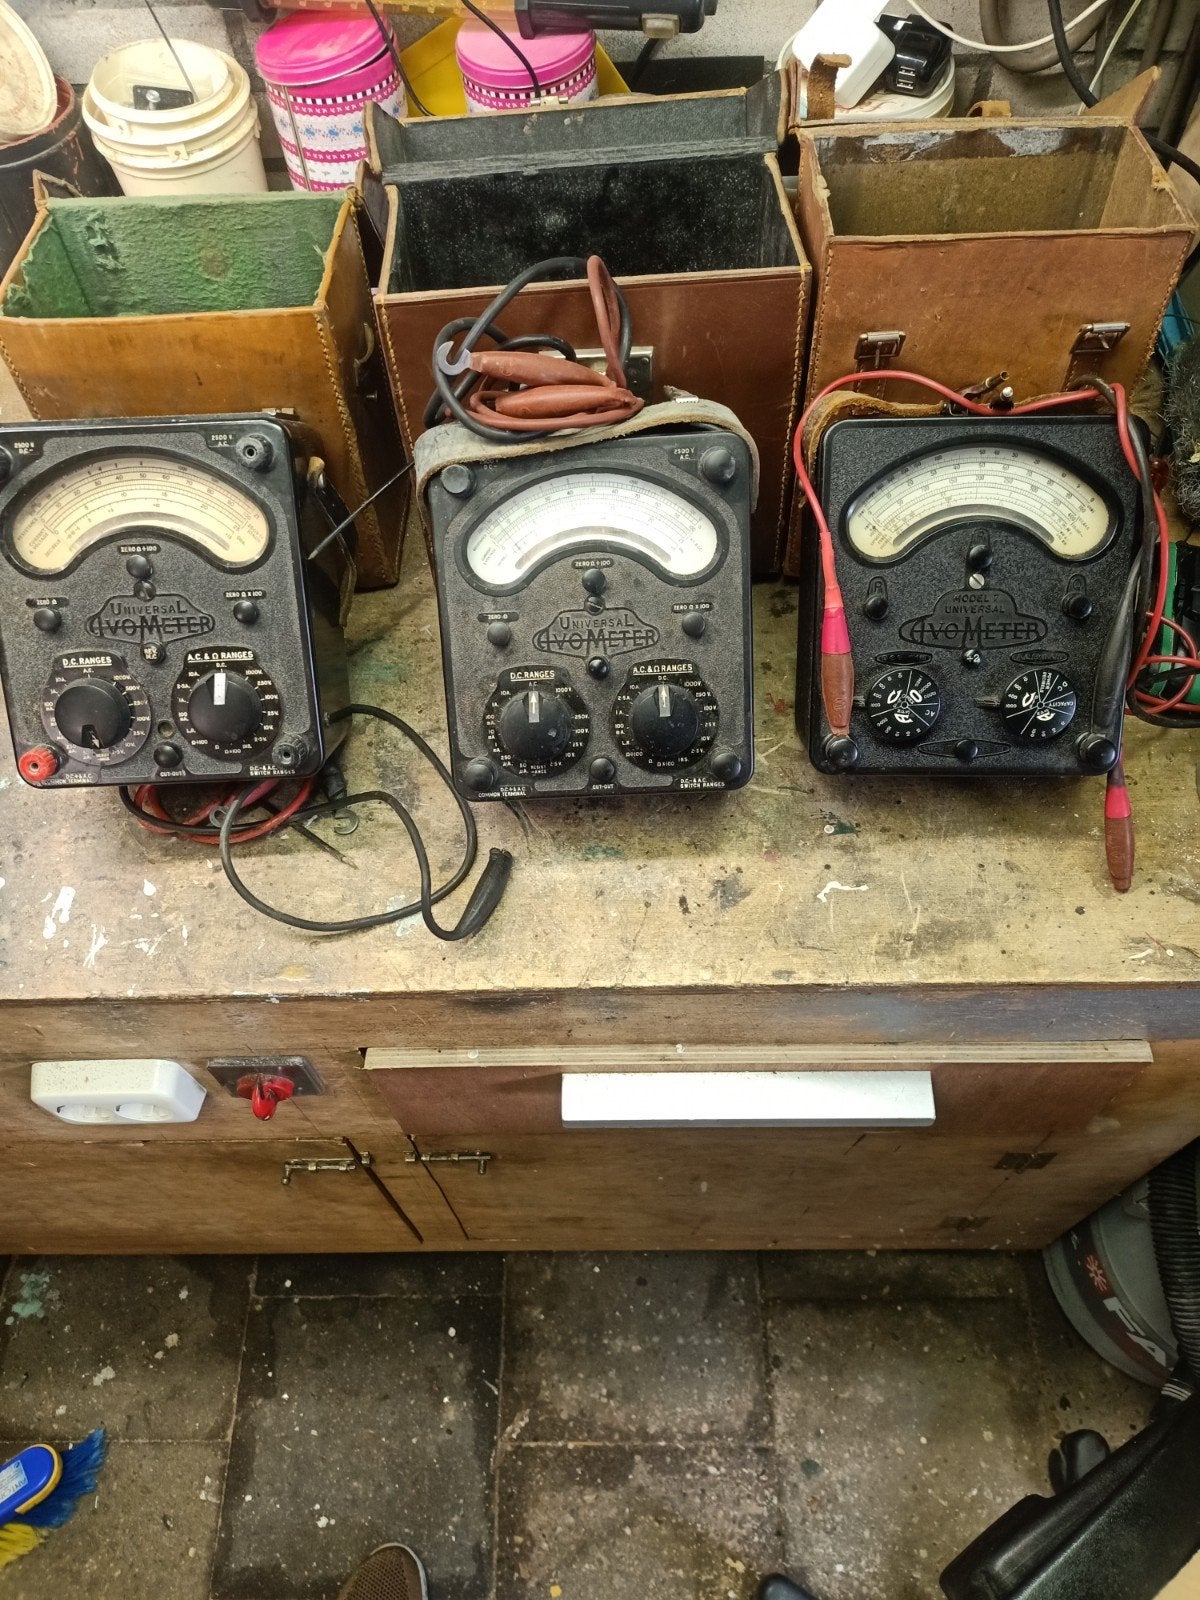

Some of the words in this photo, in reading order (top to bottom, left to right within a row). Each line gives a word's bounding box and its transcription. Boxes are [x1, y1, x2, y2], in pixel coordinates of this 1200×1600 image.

[953, 594, 989, 603] MODEL
[110, 601, 188, 616] UNIVERSAL
[945, 604, 1005, 614] UNIVERSAL
[560, 614, 634, 630] UNIVERSAL
[79, 656, 112, 664] RANGES
[204, 652, 210, 660] &
[220, 651, 254, 659] RANGES
[632, 666, 647, 674] A.C.
[662, 664, 692, 672] RANGES
[510, 672, 524, 680] D.C.
[524, 670, 554, 678] RANGES
